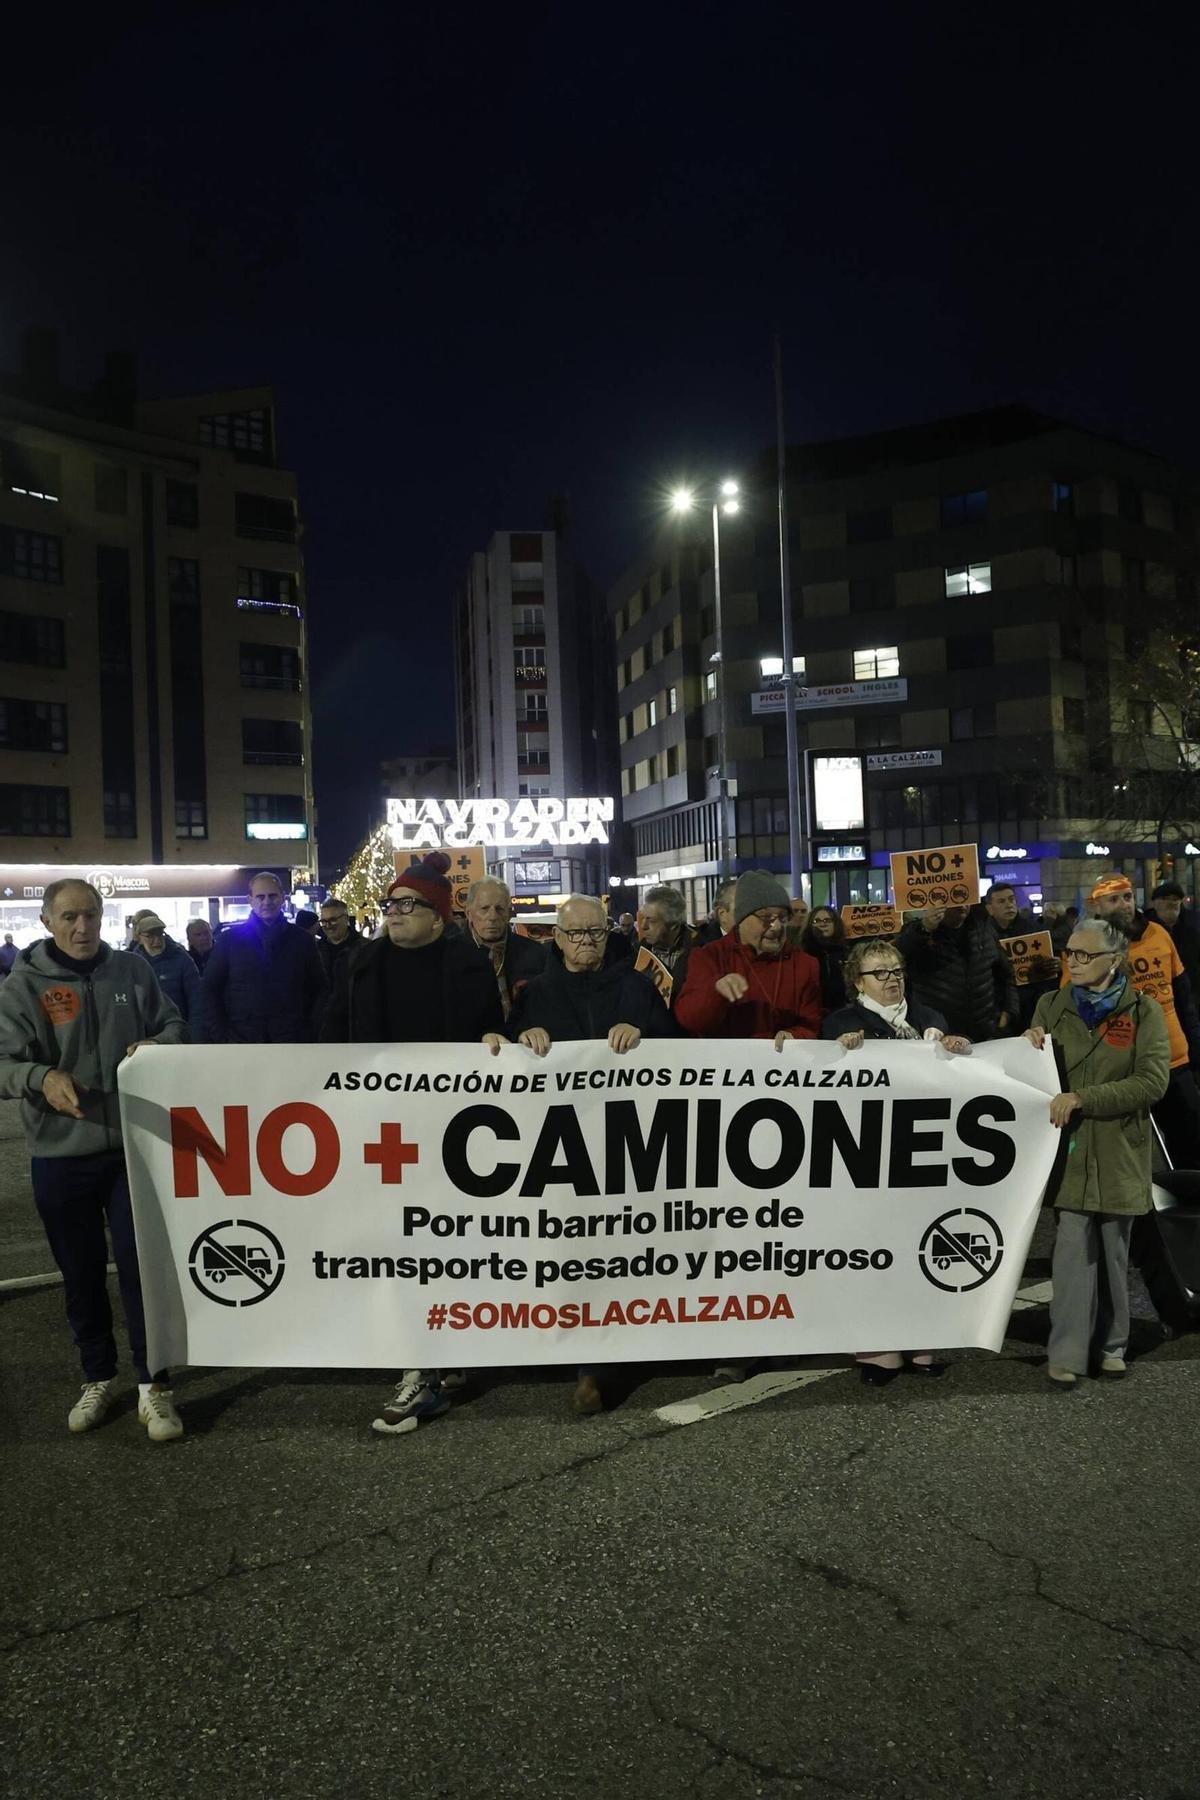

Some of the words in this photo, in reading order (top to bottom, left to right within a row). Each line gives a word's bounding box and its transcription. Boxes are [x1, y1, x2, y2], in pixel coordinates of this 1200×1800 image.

[760, 691, 808, 701] PICCALY
[817, 687, 855, 696] SCHOOL
[862, 682, 899, 692] INGLES
[891, 752, 935, 762] CALZADA
[386, 797, 564, 824] NAVIDAD
[566, 797, 614, 822] EN
[390, 822, 442, 848] LA
[443, 821, 610, 847] CALZADA
[906, 852, 946, 876] NO
[951, 854, 964, 868] +
[906, 872, 964, 886] CAMIONES
[511, 897, 536, 905] Orange
[853, 905, 880, 914] NO
[324, 1070, 502, 1093] ASOCIACIÓN
[509, 1074, 547, 1092] DE
[555, 1068, 673, 1091] VECINOS
[679, 1068, 715, 1087] DE
[722, 1068, 757, 1087] LA
[764, 1068, 891, 1088] CALZADA
[169, 1101, 341, 1198] NO
[363, 1122, 419, 1184] +
[442, 1094, 1017, 1198] CAMIONES
[403, 1206, 473, 1237] Por
[480, 1212, 530, 1238] un
[538, 1205, 657, 1239] barrio
[663, 1200, 748, 1233] libre
[755, 1198, 804, 1229] de
[312, 1250, 528, 1285] transporte
[535, 1247, 679, 1288] pesado
[684, 1252, 708, 1280] y
[714, 1242, 893, 1278] peligroso
[426, 1294, 795, 1331] #SOMOSLACALZADA
